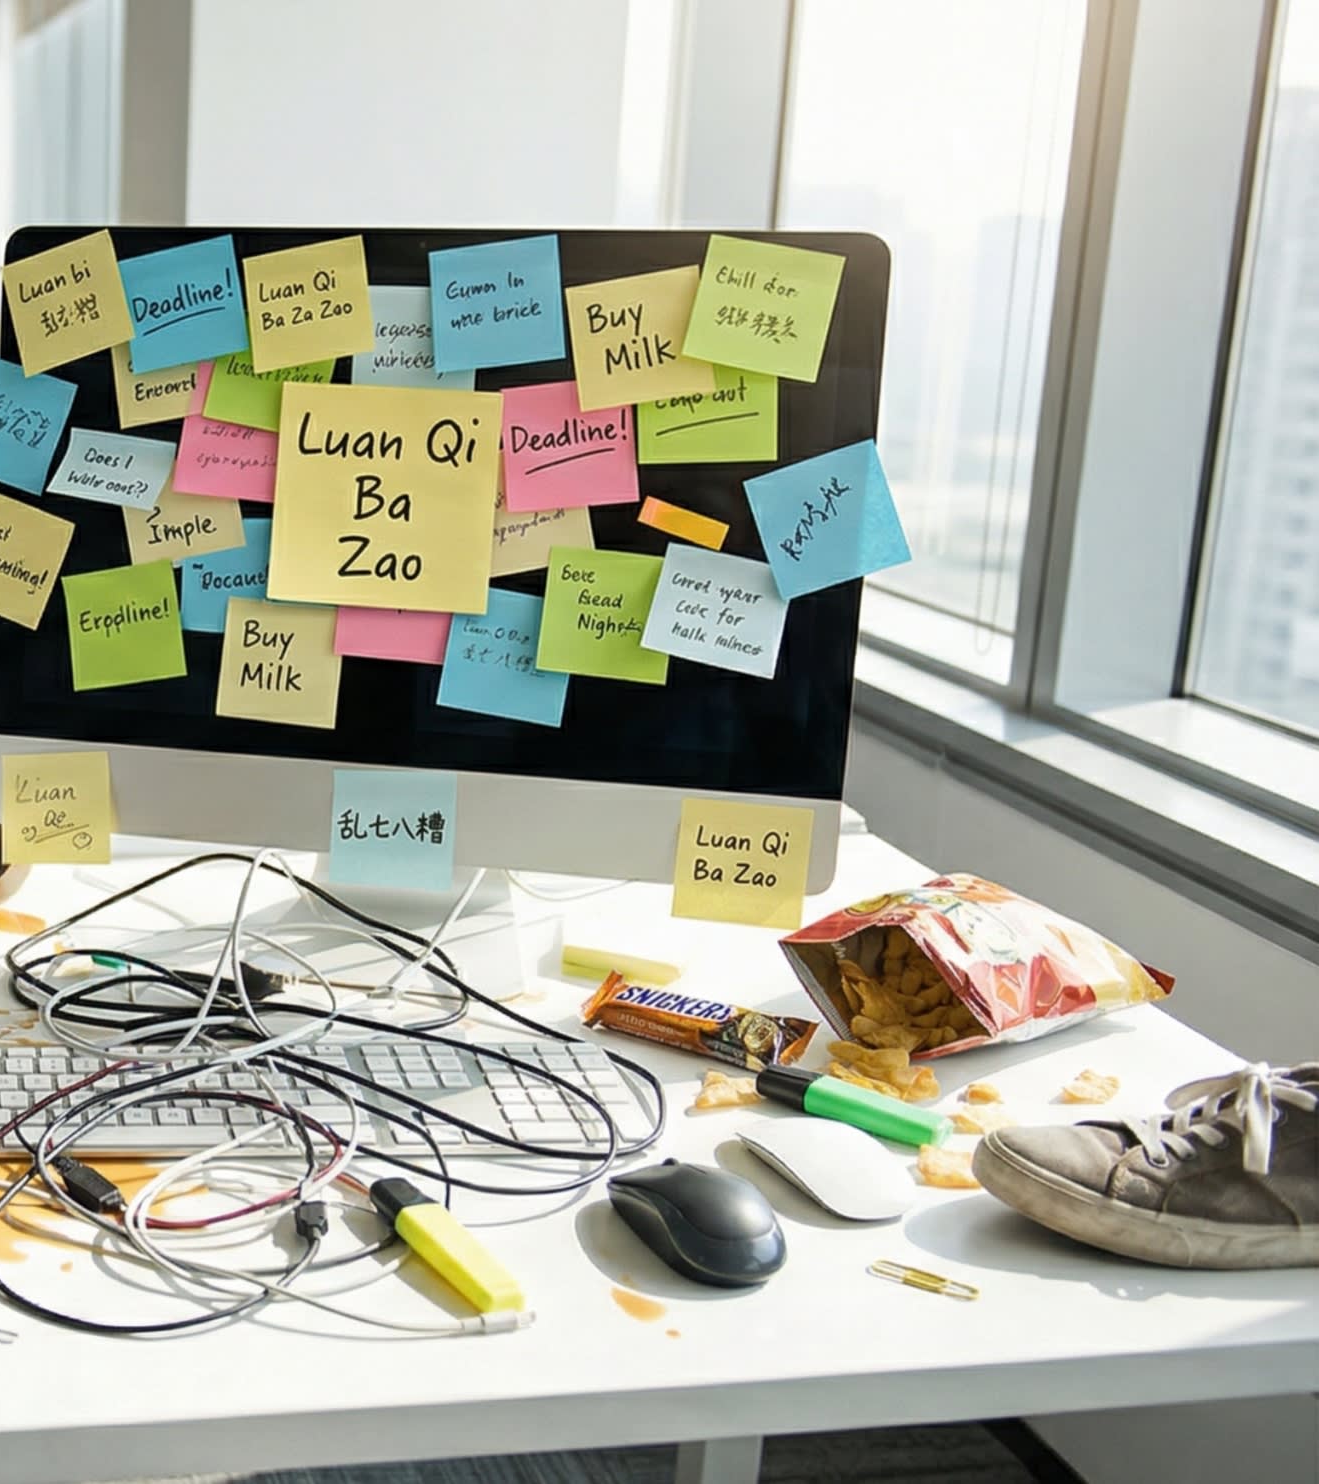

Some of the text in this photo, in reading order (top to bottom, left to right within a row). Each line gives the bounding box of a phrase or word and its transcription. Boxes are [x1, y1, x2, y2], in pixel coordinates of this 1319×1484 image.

[19, 260, 91, 304] Luan bi
[132, 267, 234, 323] Deadline!
[258, 270, 337, 303] Luan Qi
[262, 300, 353, 331] Ba Za Zao
[586, 303, 643, 336] Buy
[605, 334, 677, 375] Milk
[297, 411, 481, 467] Luan Qi
[511, 409, 627, 453] Deadline!
[353, 474, 412, 522] Ba
[337, 535, 423, 582] Zao
[716, 607, 746, 627] for
[243, 619, 295, 660] Buy
[239, 662, 302, 692] Milk
[336, 810, 446, 845] 乱七八糟
[695, 824, 789, 860] Luan Qi
[693, 861, 778, 889] Ba Zao
